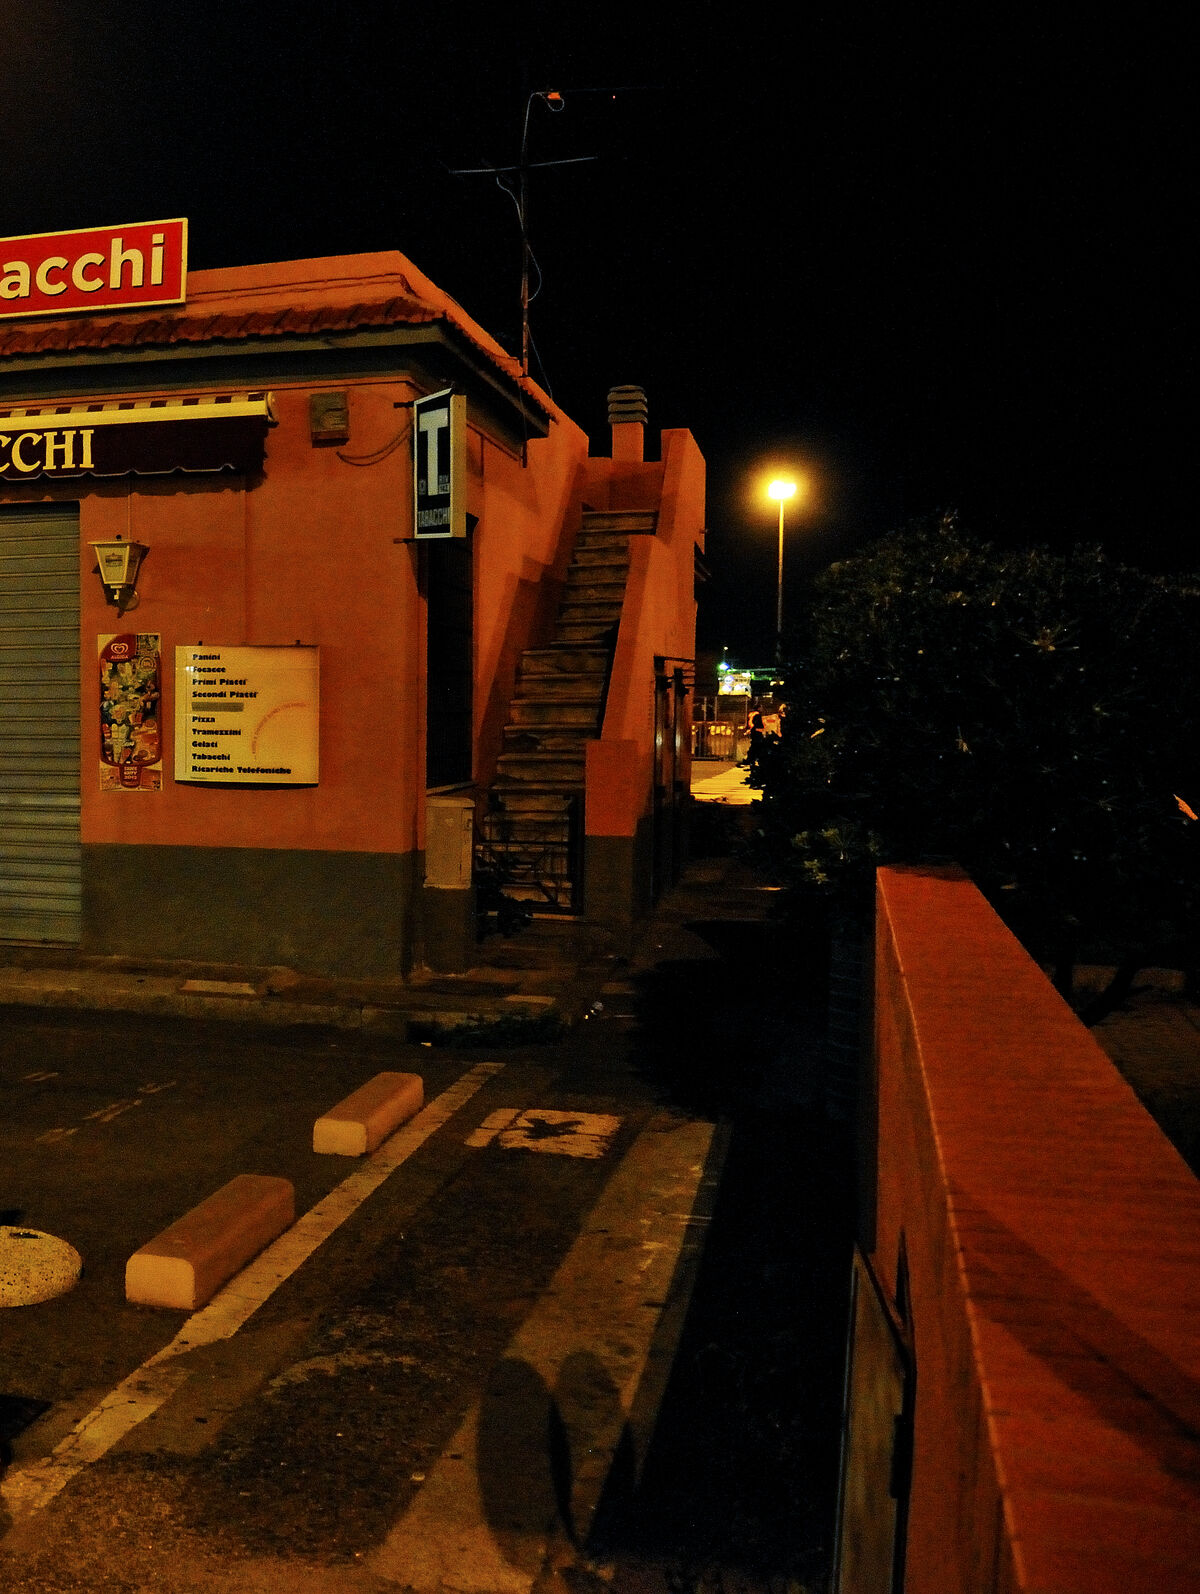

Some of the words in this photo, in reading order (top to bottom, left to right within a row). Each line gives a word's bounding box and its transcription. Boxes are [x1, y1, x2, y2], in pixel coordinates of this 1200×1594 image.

[419, 407, 449, 496] T
[418, 507, 450, 527] TABACCHI
[192, 740, 218, 748] Gelati
[192, 765, 234, 773] Ricariche
[237, 766, 292, 774] Telefoniche
